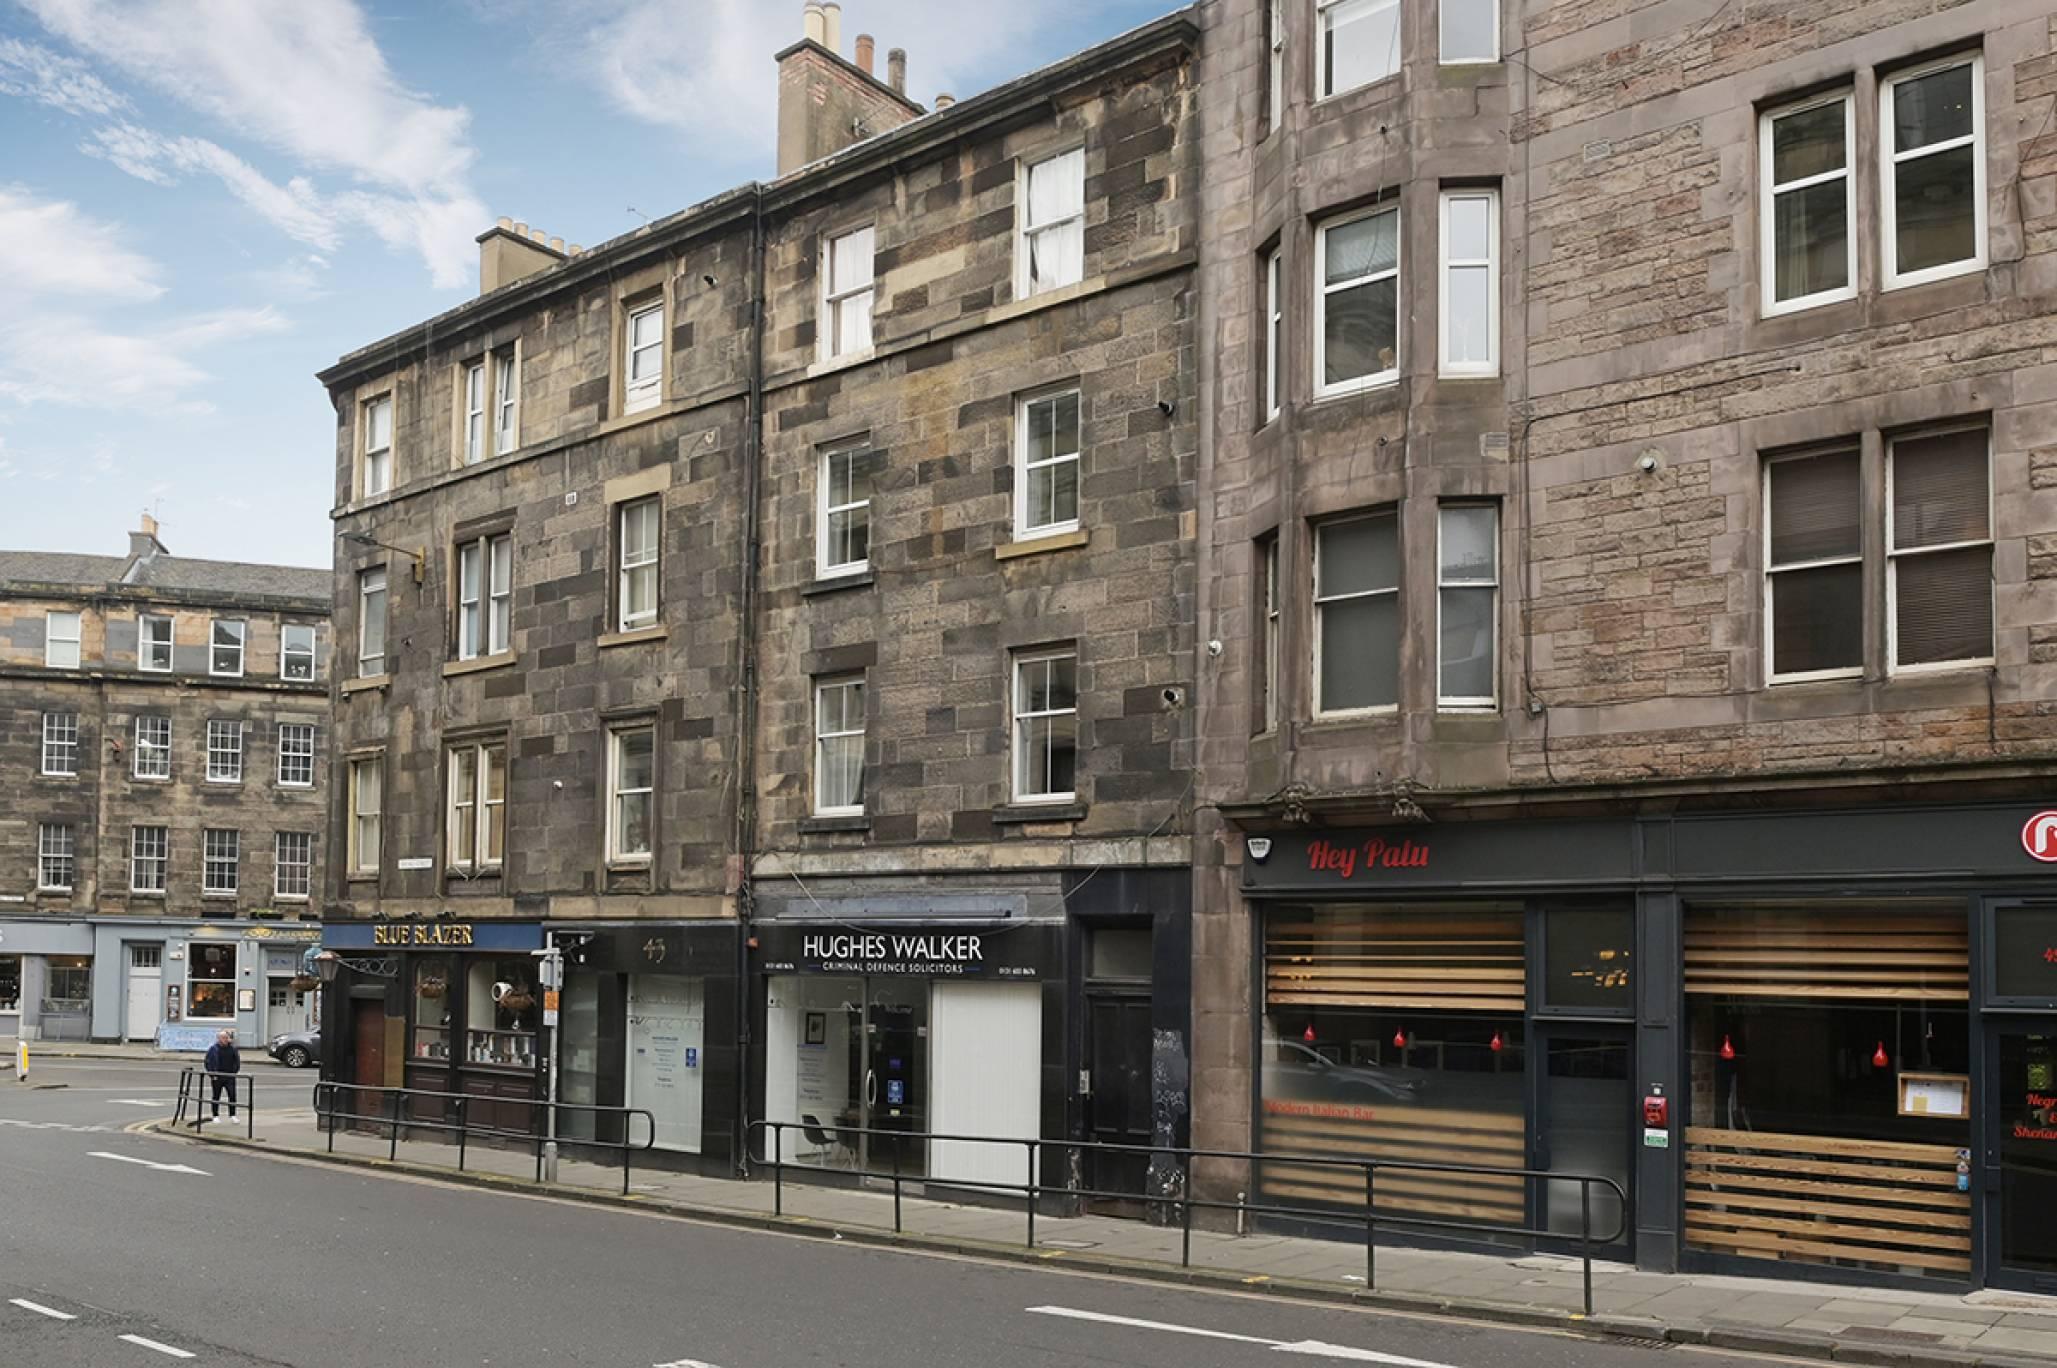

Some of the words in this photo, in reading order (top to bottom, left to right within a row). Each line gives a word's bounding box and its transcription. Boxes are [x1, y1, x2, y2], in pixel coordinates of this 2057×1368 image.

[1307, 839, 1356, 877] Hey
[1364, 837, 1429, 868] Palu
[374, 924, 410, 944] BLUE
[414, 923, 473, 944] BLAZER
[803, 935, 886, 959] HUGHES
[891, 935, 983, 960] WALKER
[822, 961, 863, 972] CRIMINAL
[866, 962, 906, 973] DEFENCE
[908, 963, 963, 973] SOLICITORS
[1264, 1099, 1310, 1115] Modern
[1313, 1102, 1350, 1118] Italian
[1353, 1106, 1376, 1120] Bar
